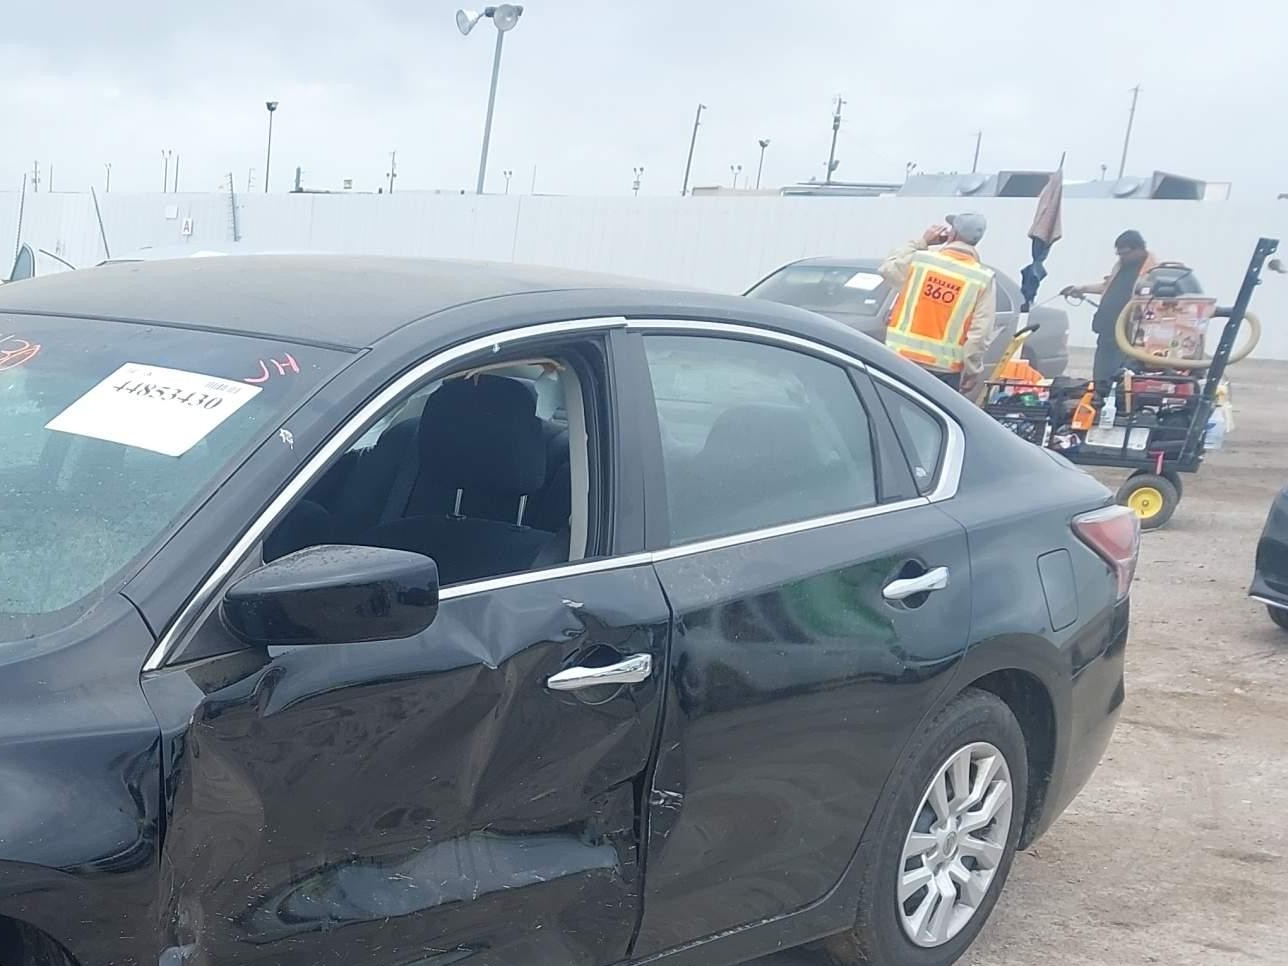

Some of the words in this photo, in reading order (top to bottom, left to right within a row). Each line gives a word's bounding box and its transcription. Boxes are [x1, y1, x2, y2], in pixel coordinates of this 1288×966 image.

[183, 219, 191, 233] A
[924, 283, 956, 304] 360
[112, 380, 224, 410] 44853430
